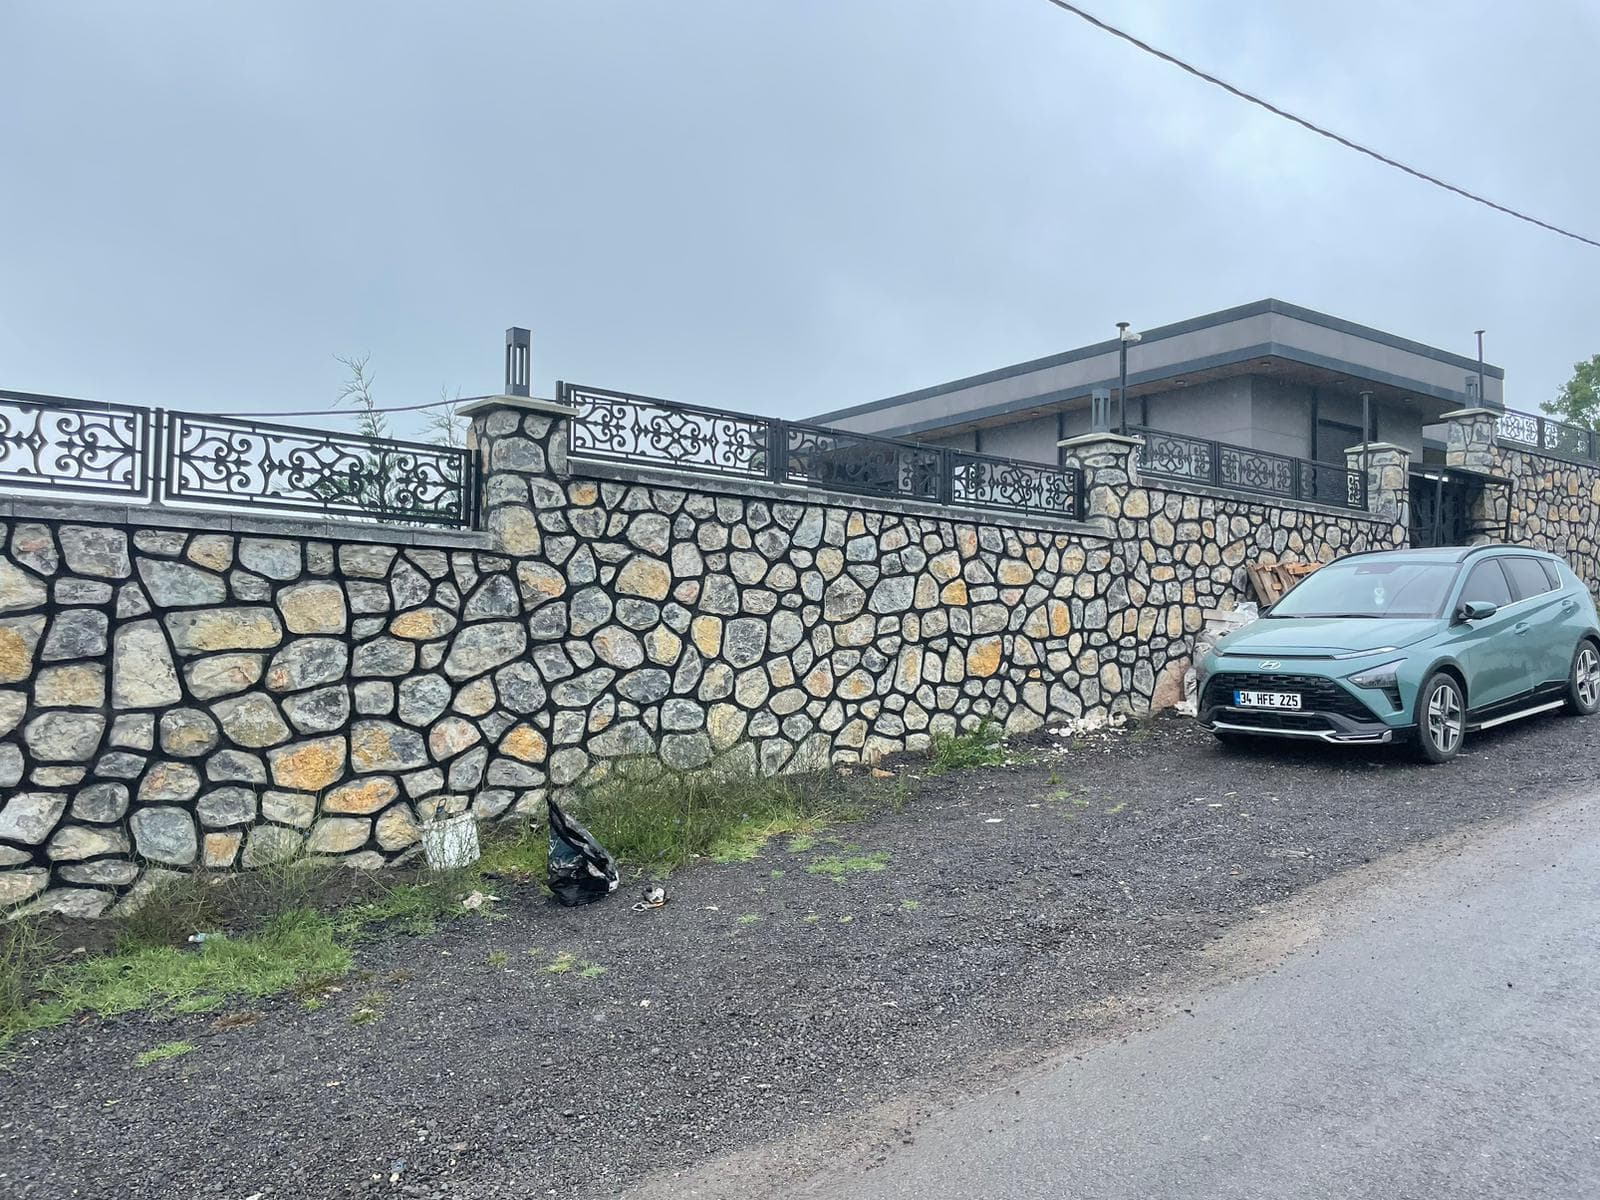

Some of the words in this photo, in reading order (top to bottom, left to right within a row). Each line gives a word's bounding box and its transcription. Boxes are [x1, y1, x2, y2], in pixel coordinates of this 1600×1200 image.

[1240, 692, 1252, 704] 34
[1257, 693, 1275, 706] HFE
[1280, 694, 1298, 707] 225
